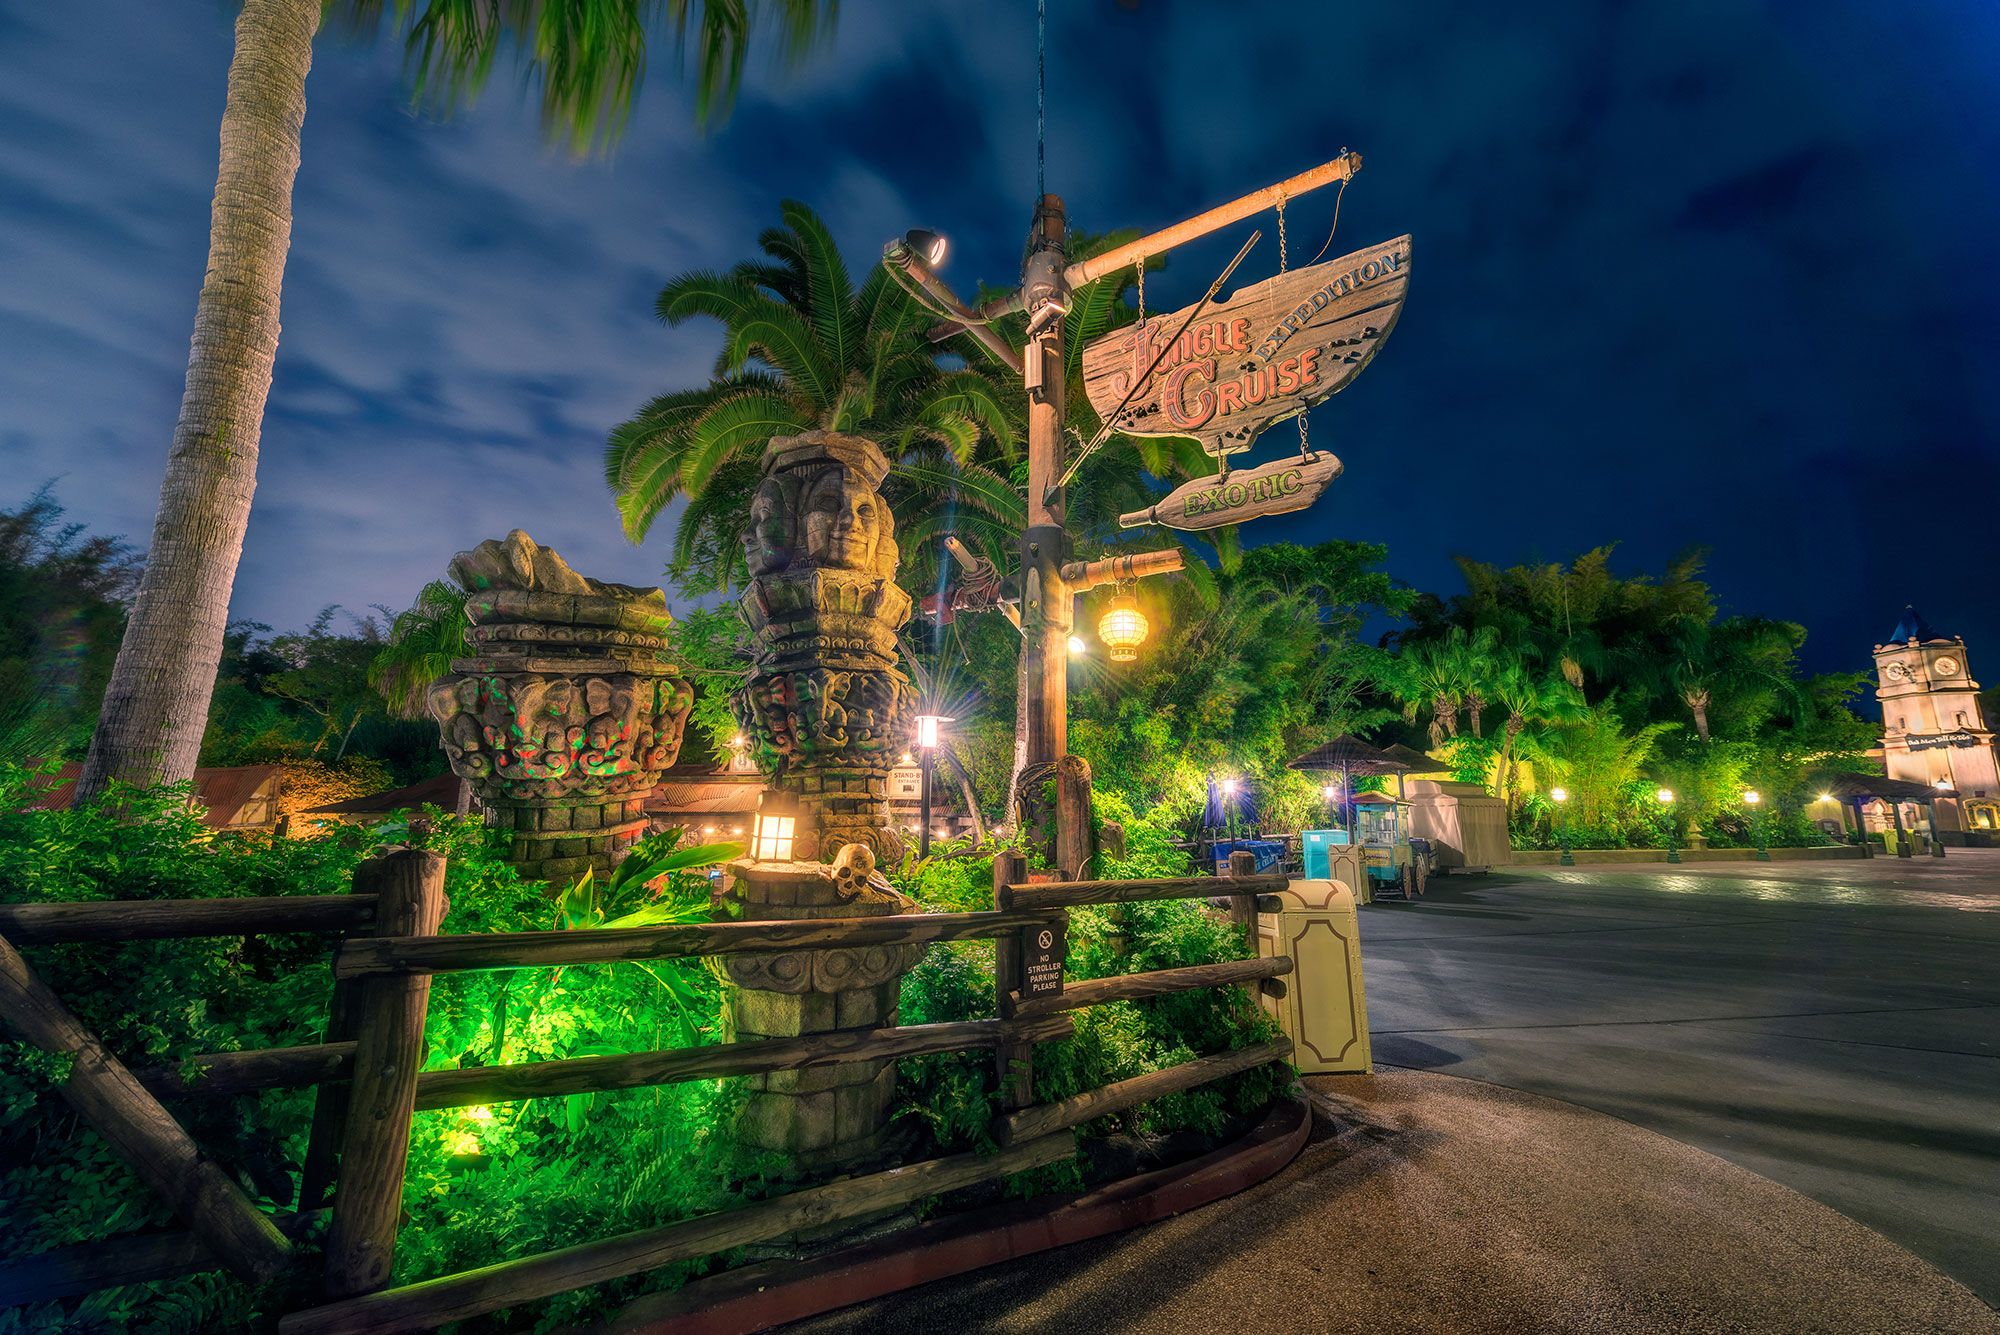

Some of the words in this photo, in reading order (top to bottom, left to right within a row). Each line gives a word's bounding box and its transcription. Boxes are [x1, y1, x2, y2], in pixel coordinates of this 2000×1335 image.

[1254, 252, 1401, 363] EXPEDITION
[1111, 317, 1252, 401] JUNGLE
[1163, 347, 1321, 429] CRUISE
[1182, 469, 1304, 518] EXOTIC
[1028, 962, 1062, 974] STROLLER
[1040, 954, 1049, 962] NO
[1030, 972, 1059, 983] PARKING
[1033, 981, 1057, 992] PLEASE
